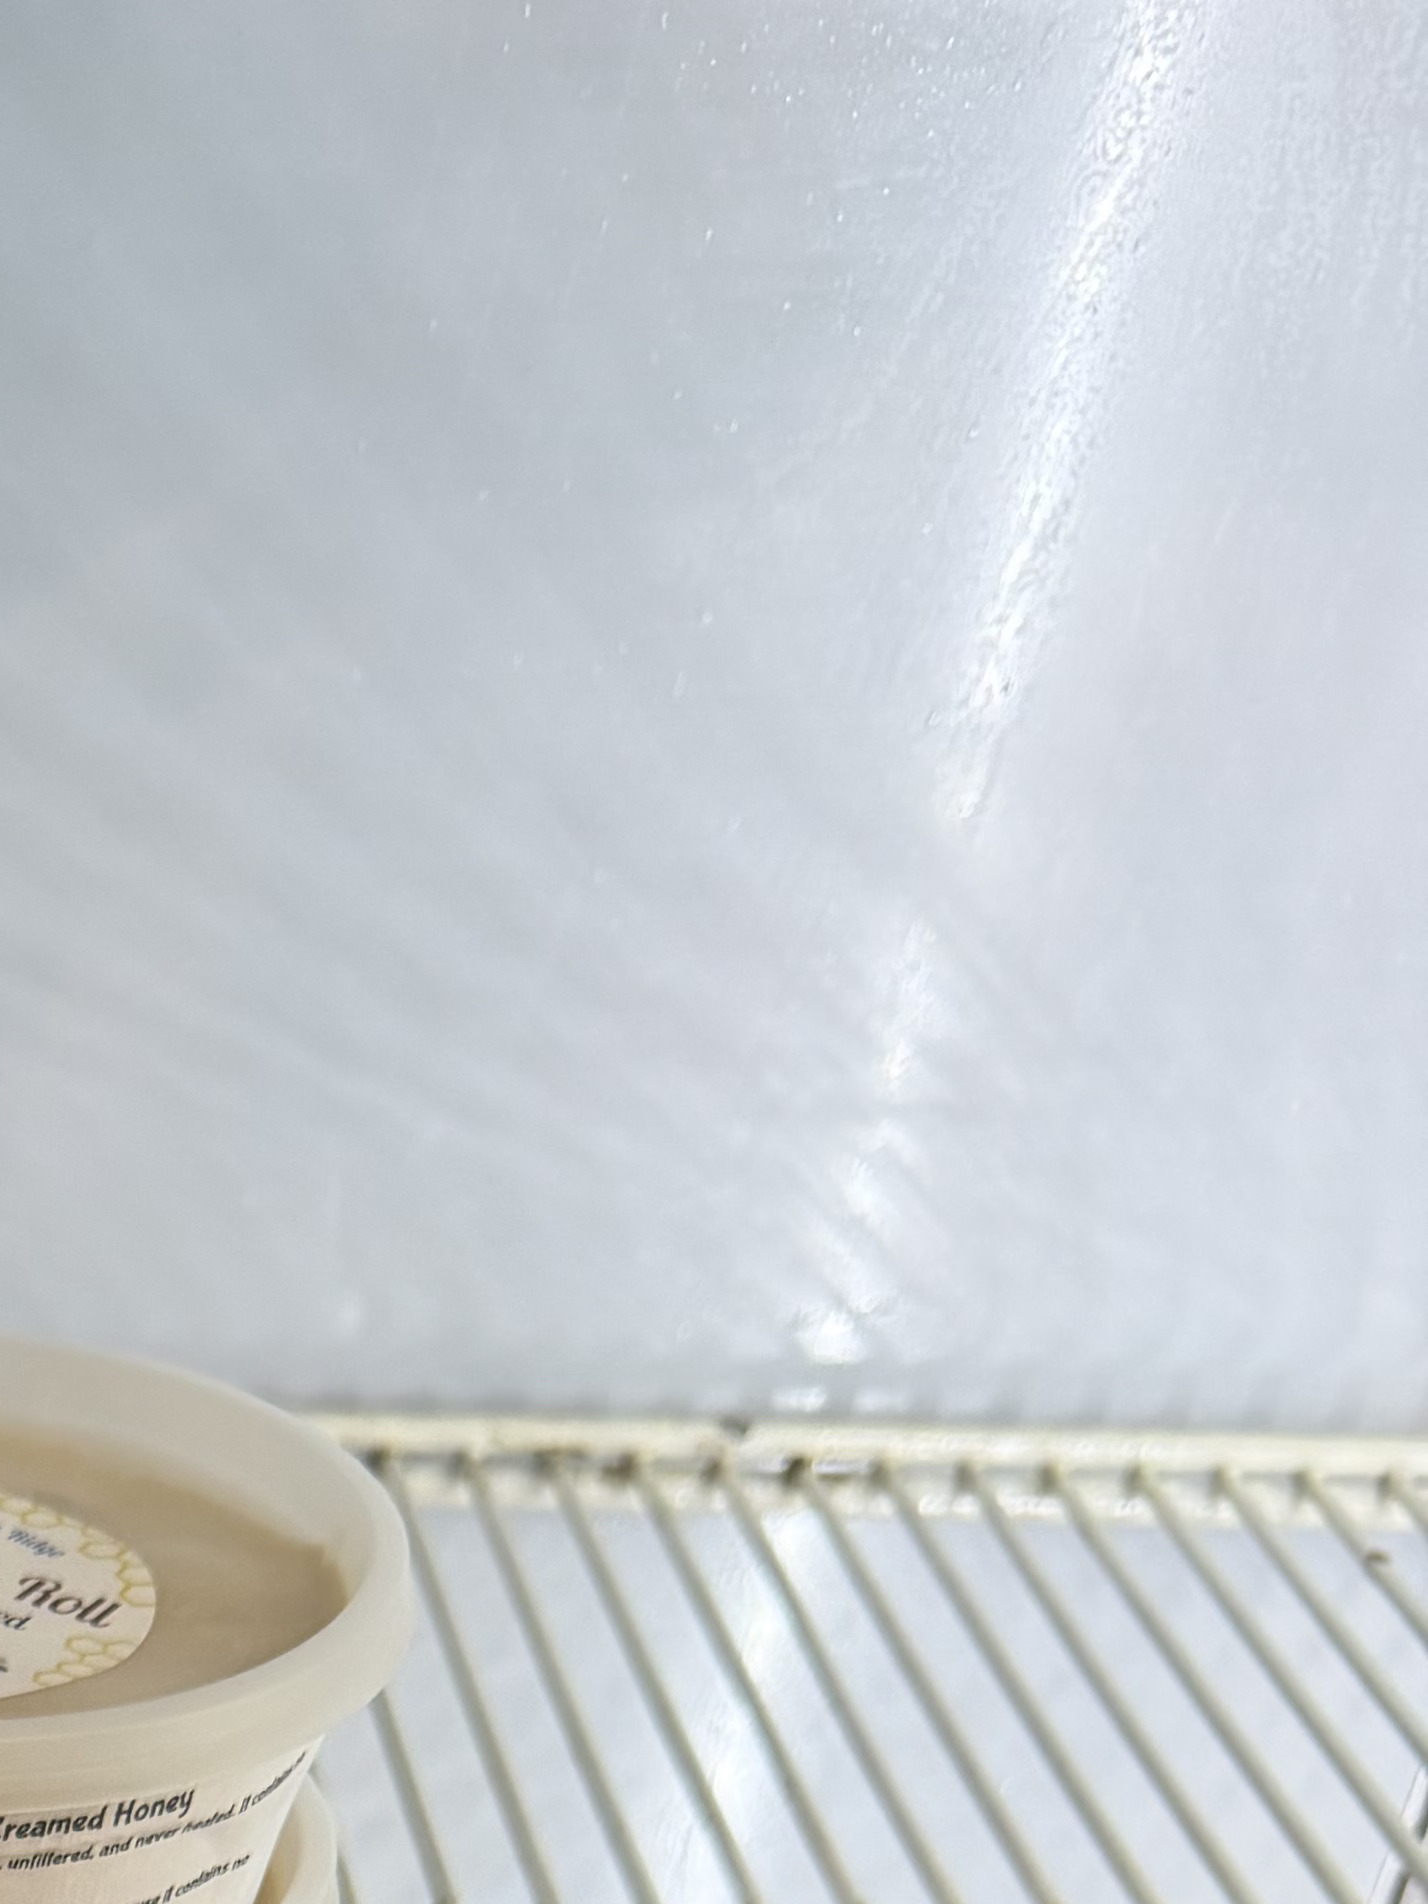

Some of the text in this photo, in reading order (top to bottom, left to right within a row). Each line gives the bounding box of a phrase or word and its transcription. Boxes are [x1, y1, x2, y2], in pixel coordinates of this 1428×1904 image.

[9, 1529, 65, 1559] Ridge
[19, 1576, 122, 1630] Roll
[114, 1789, 195, 1828] Honey
